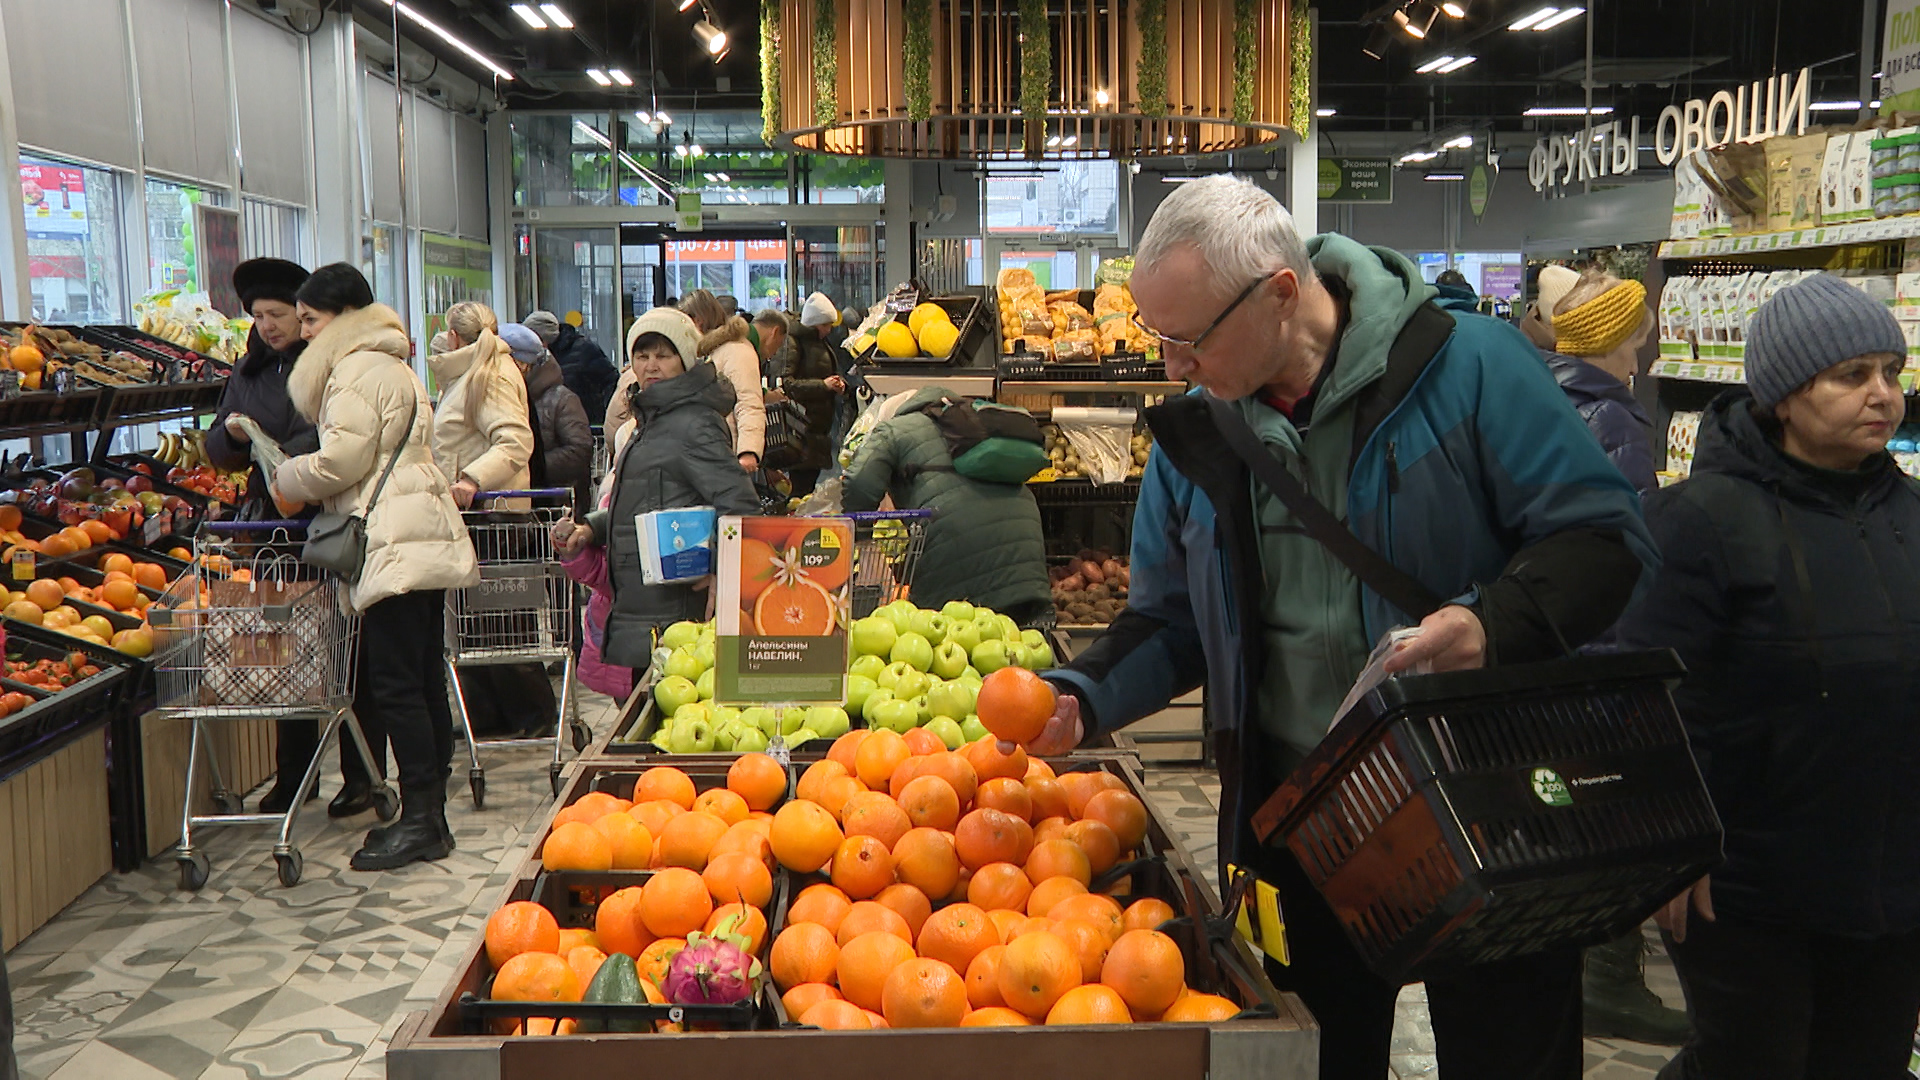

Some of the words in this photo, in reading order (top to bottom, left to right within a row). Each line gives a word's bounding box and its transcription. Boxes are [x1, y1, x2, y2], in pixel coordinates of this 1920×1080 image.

[1528, 115, 1640, 192] ФРУКТЫ
[1656, 67, 1812, 166] ОВОЩИ
[803, 555, 823, 566] 109
[748, 640, 808, 650] Апельсины
[748, 651, 803, 661] НАВЕЛИН,
